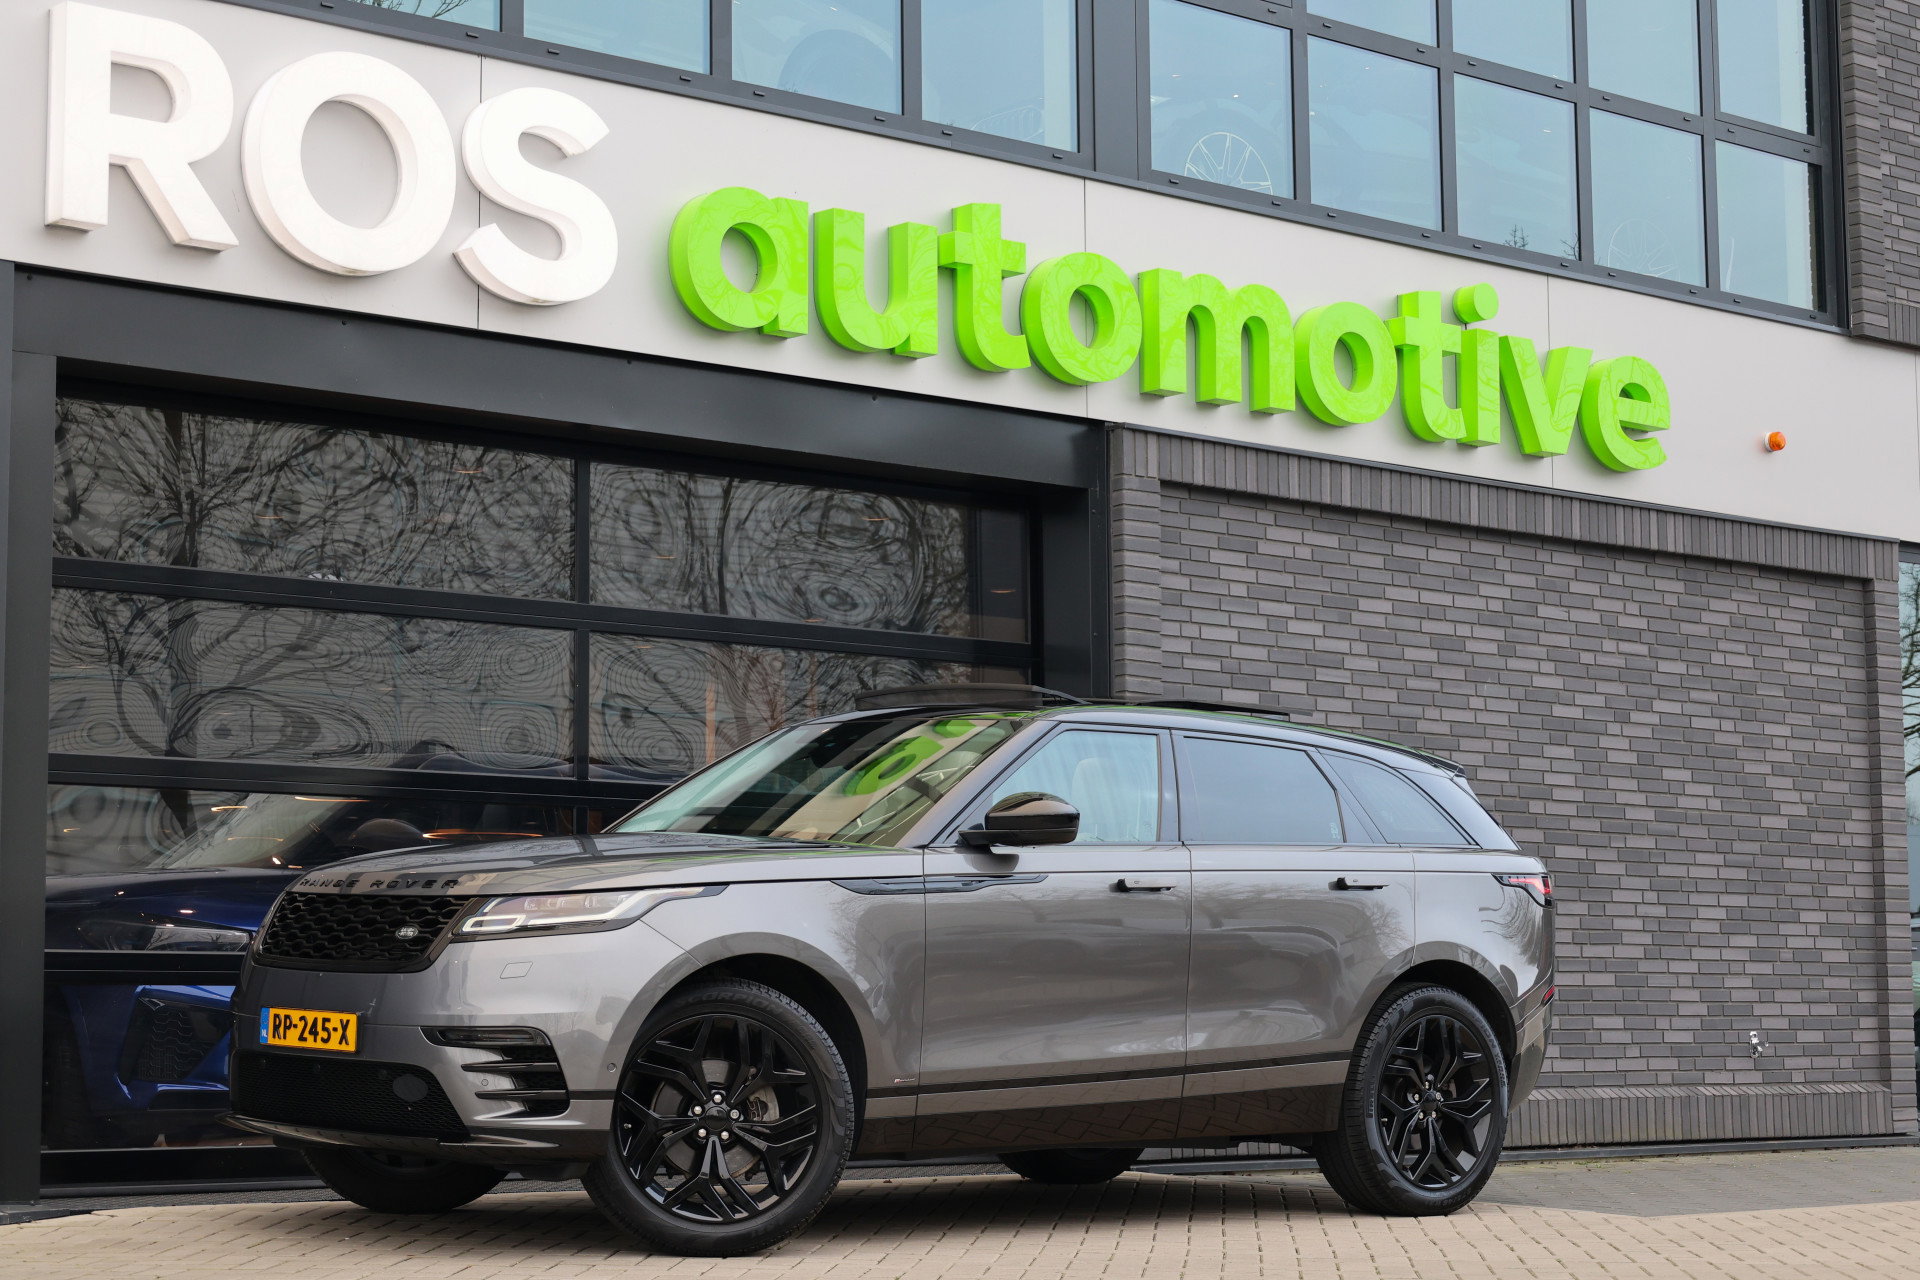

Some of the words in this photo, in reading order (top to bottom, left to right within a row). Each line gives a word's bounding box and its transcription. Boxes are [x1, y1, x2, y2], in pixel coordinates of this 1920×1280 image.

[45, 1, 618, 306] ROS
[669, 186, 1670, 471] automotive
[299, 878, 360, 888] RANGE
[370, 879, 459, 889] ROVER
[272, 1013, 350, 1046] RP-245-X
